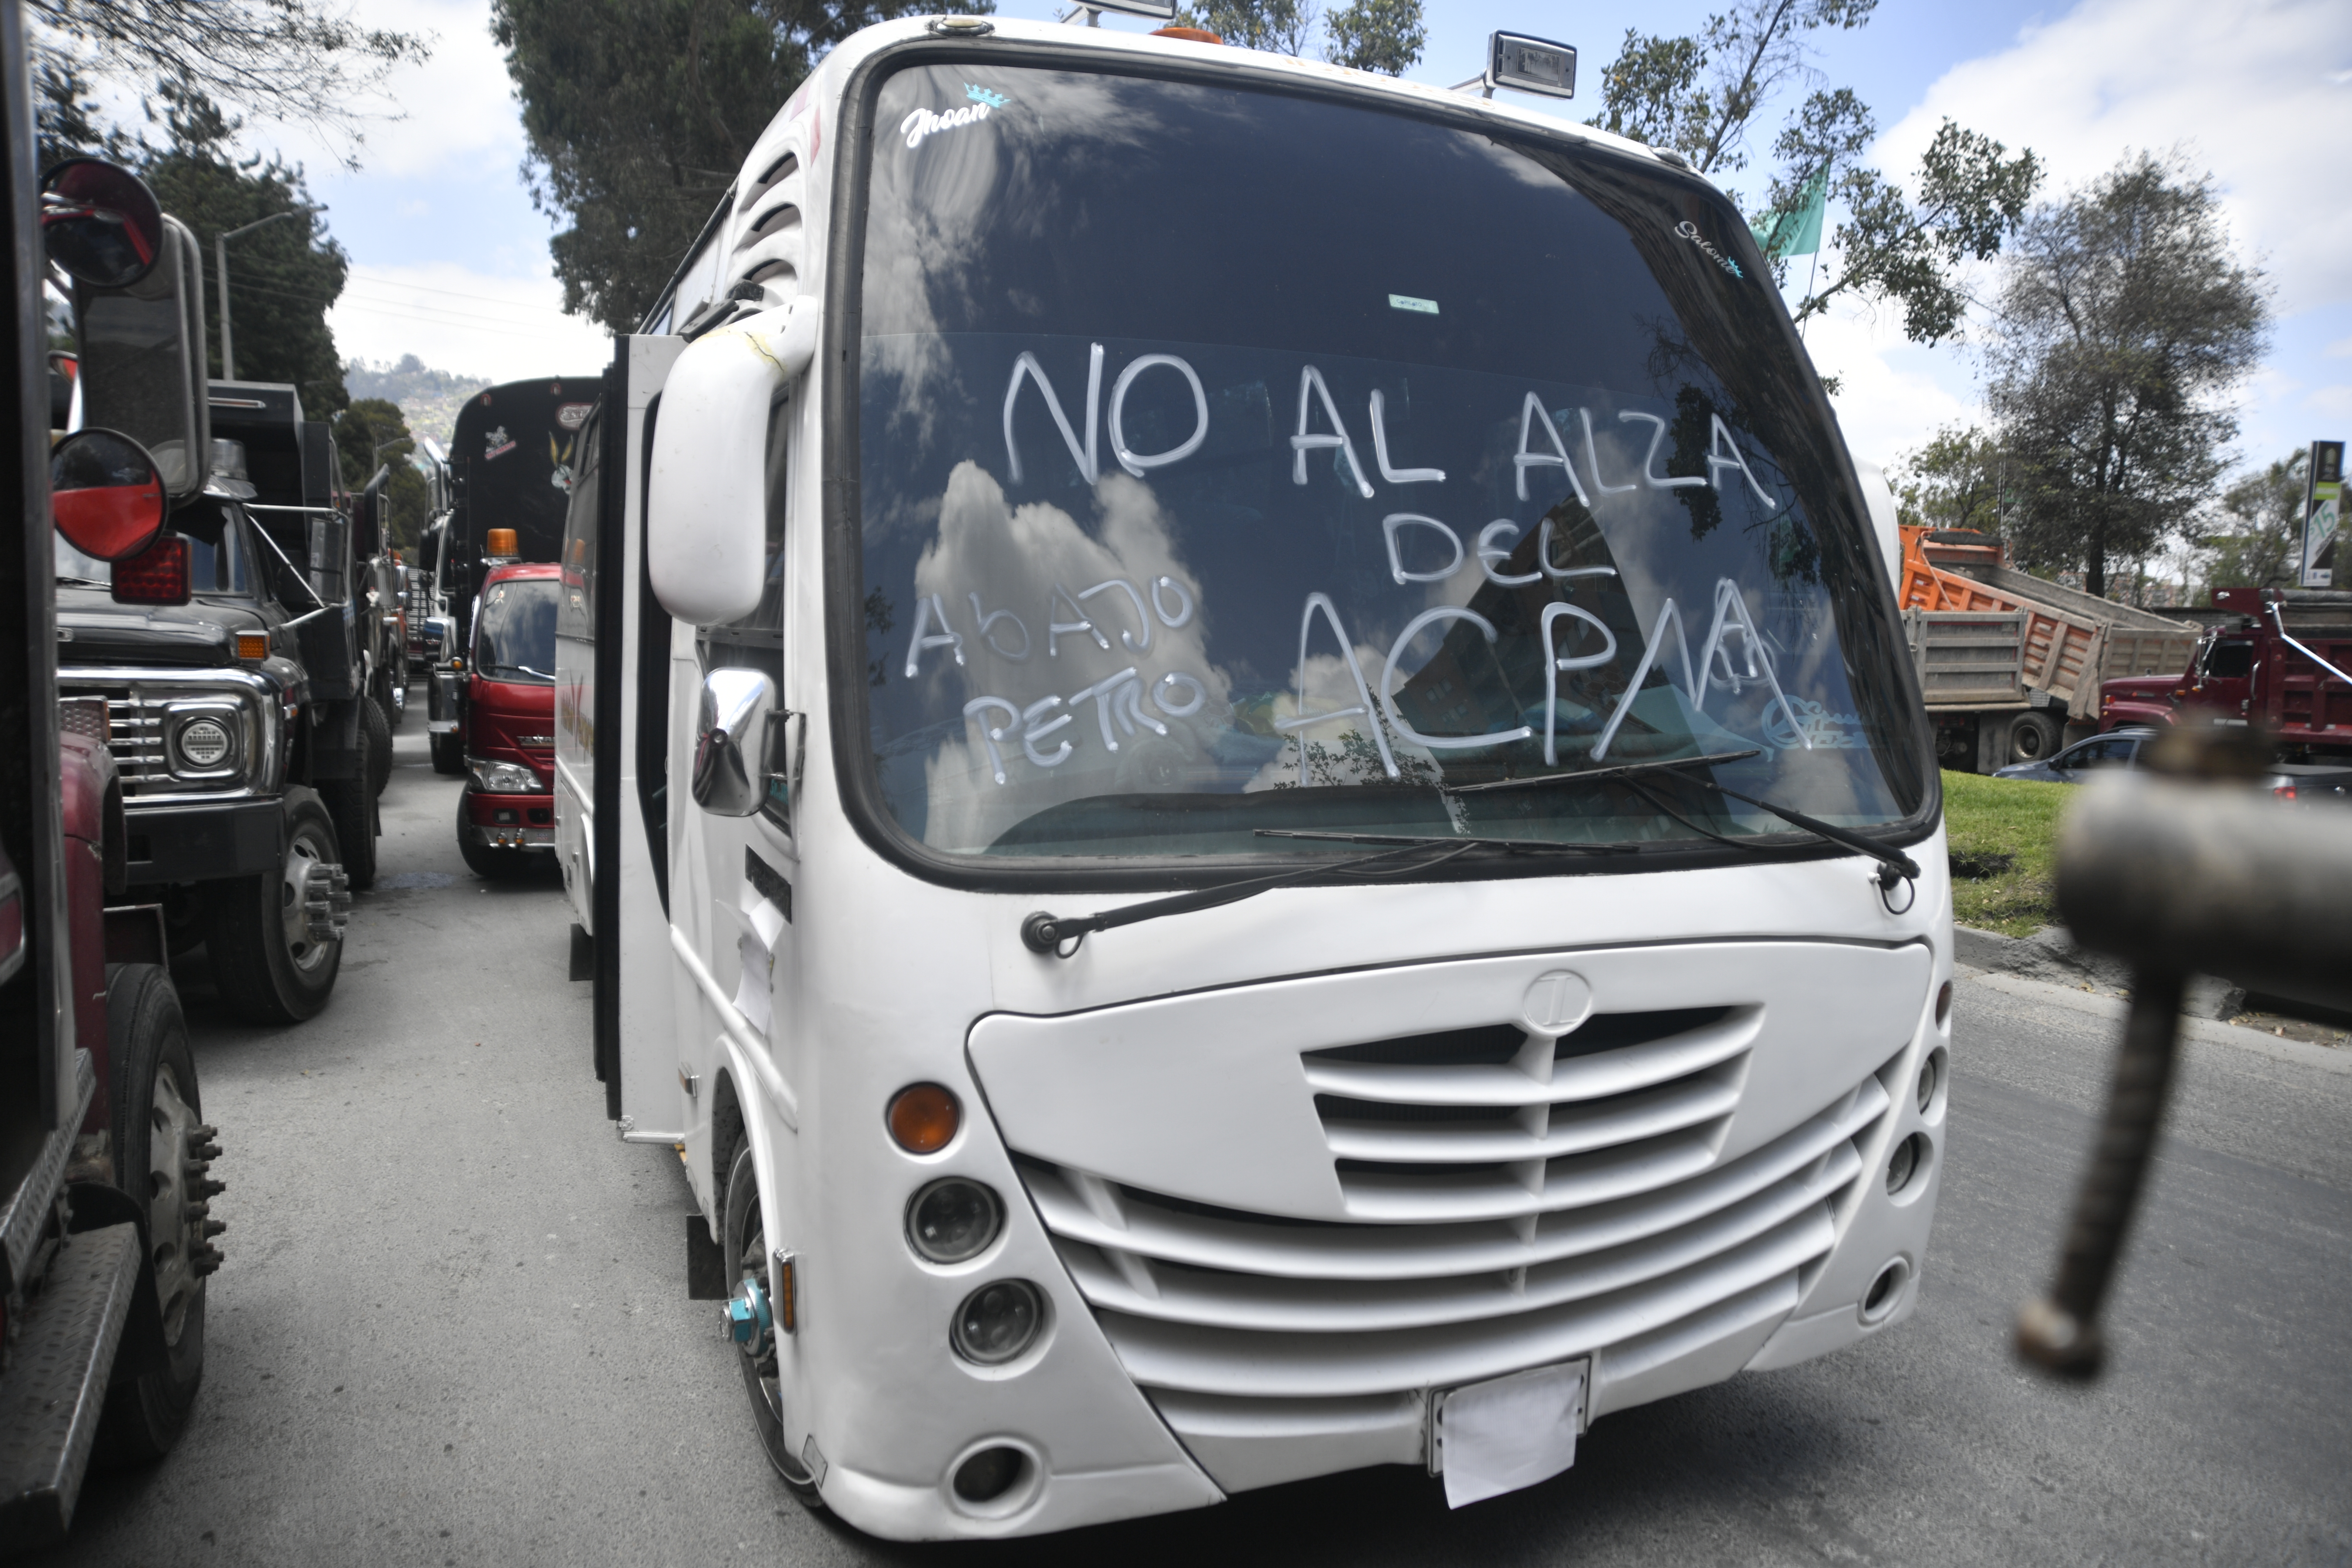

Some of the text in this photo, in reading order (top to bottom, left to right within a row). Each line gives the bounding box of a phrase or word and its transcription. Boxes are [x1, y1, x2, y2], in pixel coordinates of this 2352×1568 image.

[900, 102, 990, 148] Jhoan
[1003, 341, 1776, 507] NO AL ALZA
[1382, 512, 1618, 585] DEL
[962, 666, 1206, 786] PETRO
[1274, 577, 1813, 788] ACPM
